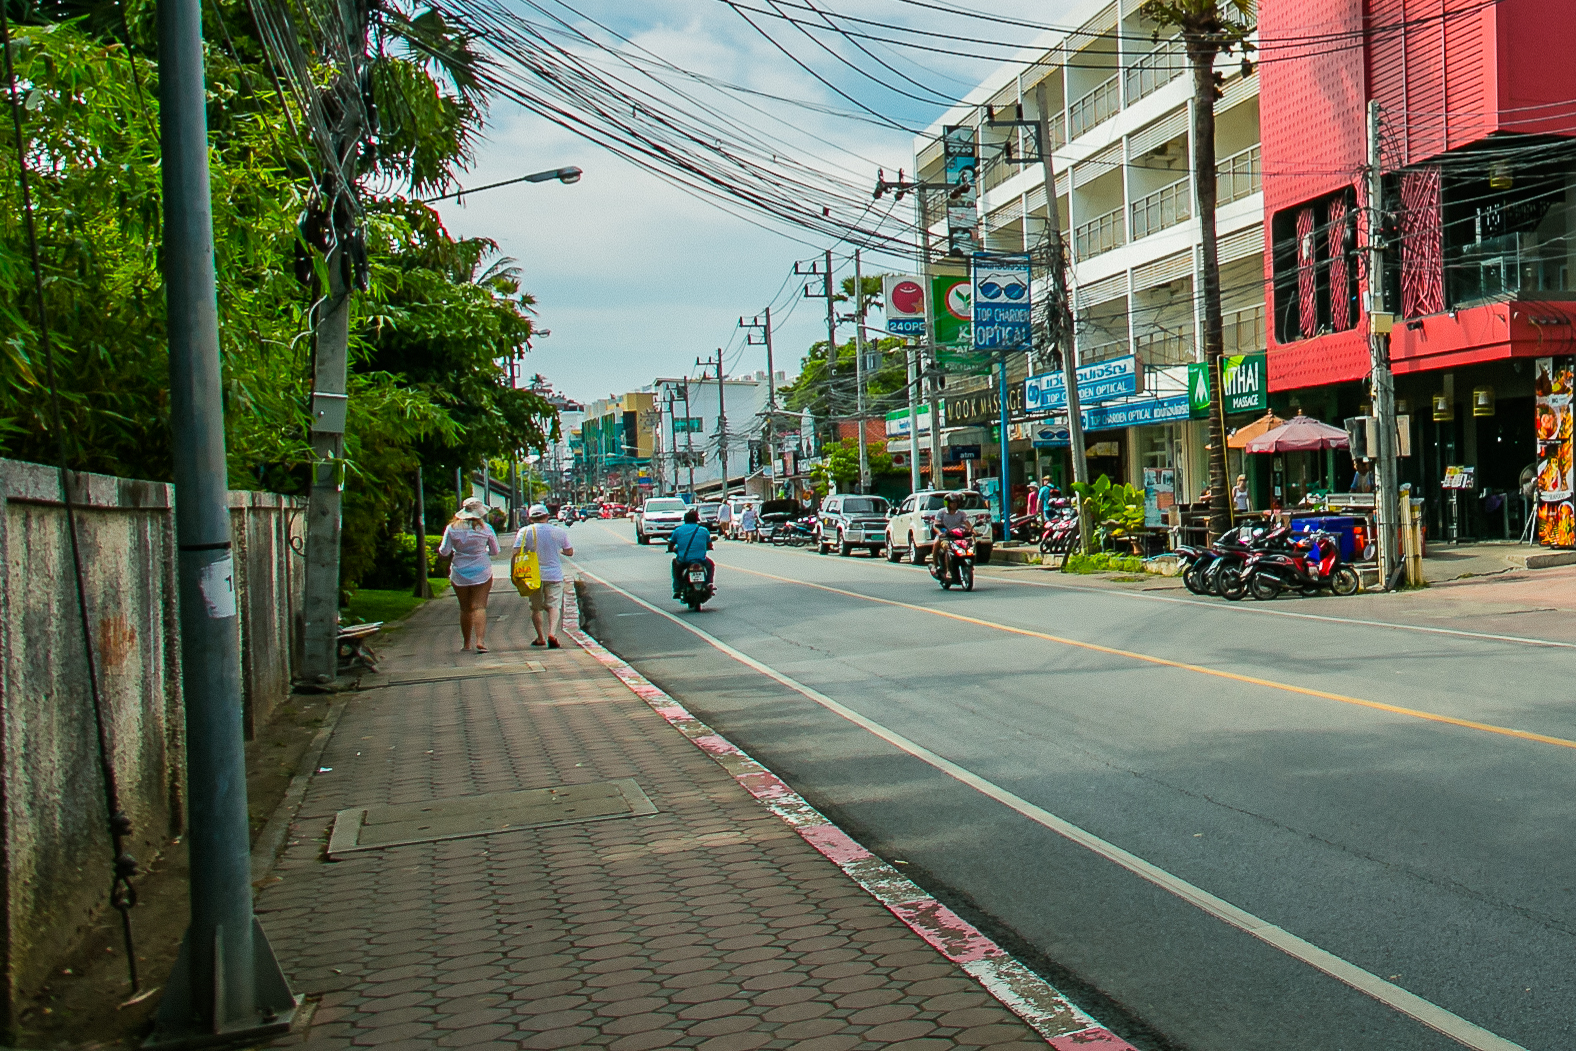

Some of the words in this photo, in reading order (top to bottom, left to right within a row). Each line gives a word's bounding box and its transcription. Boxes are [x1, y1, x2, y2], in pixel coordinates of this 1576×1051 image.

[976, 307, 993, 321] TOP
[889, 321, 926, 331] 24OPE
[976, 324, 1027, 346] OPTICAL
[1046, 393, 1060, 403] TOP
[1096, 381, 1127, 395] OPTICAL
[1232, 394, 1259, 408] MASSAGE
[1090, 416, 1100, 426] TOP
[1128, 408, 1151, 421] OPTICAL
[959, 451, 975, 459] atm
